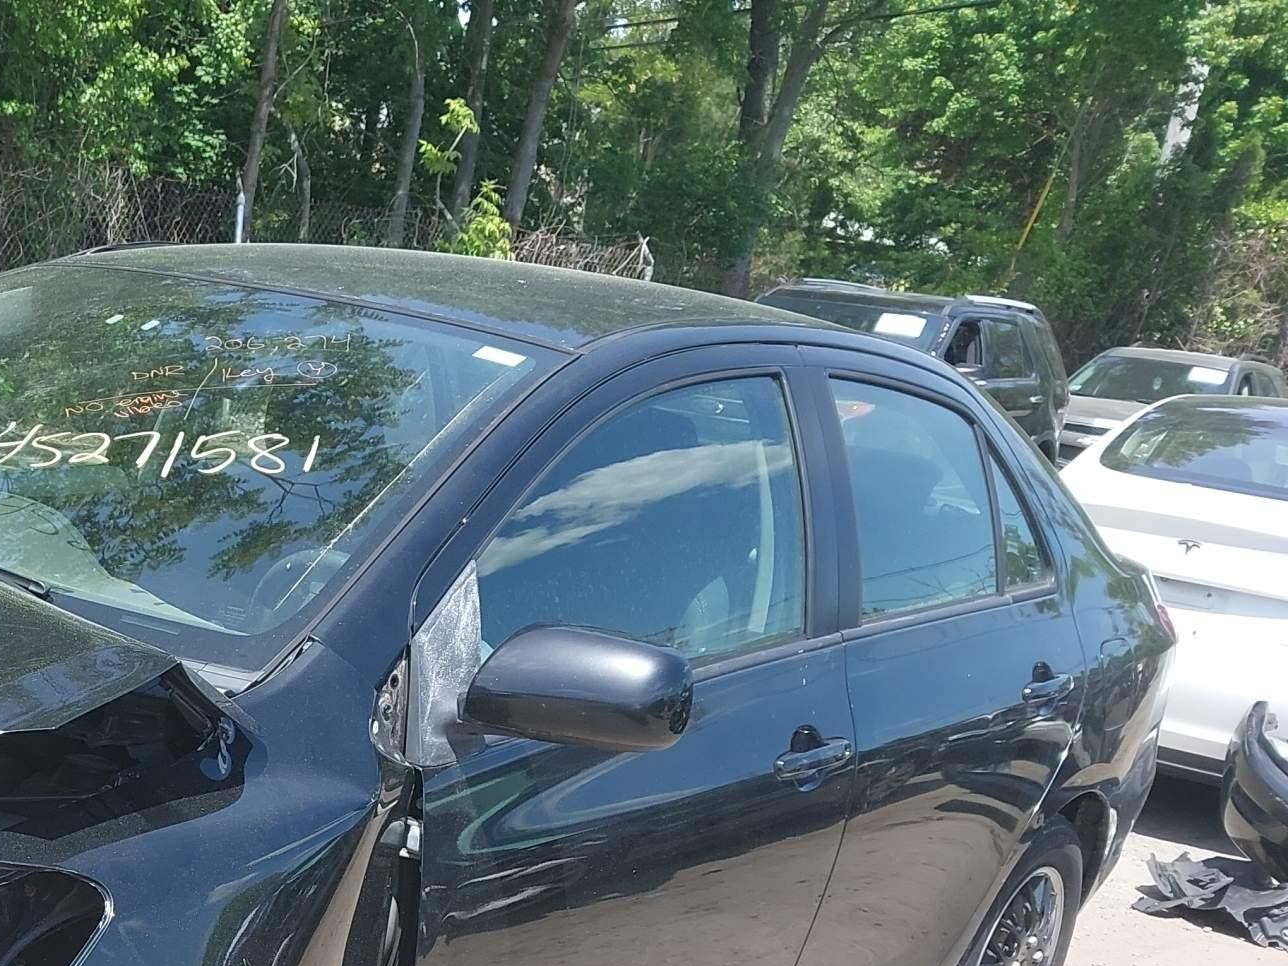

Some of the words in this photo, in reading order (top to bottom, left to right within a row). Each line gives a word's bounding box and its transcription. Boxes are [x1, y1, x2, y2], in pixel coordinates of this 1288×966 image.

[205, 333, 351, 356] 206,274
[130, 364, 185, 381] DNR
[222, 366, 281, 384] Key
